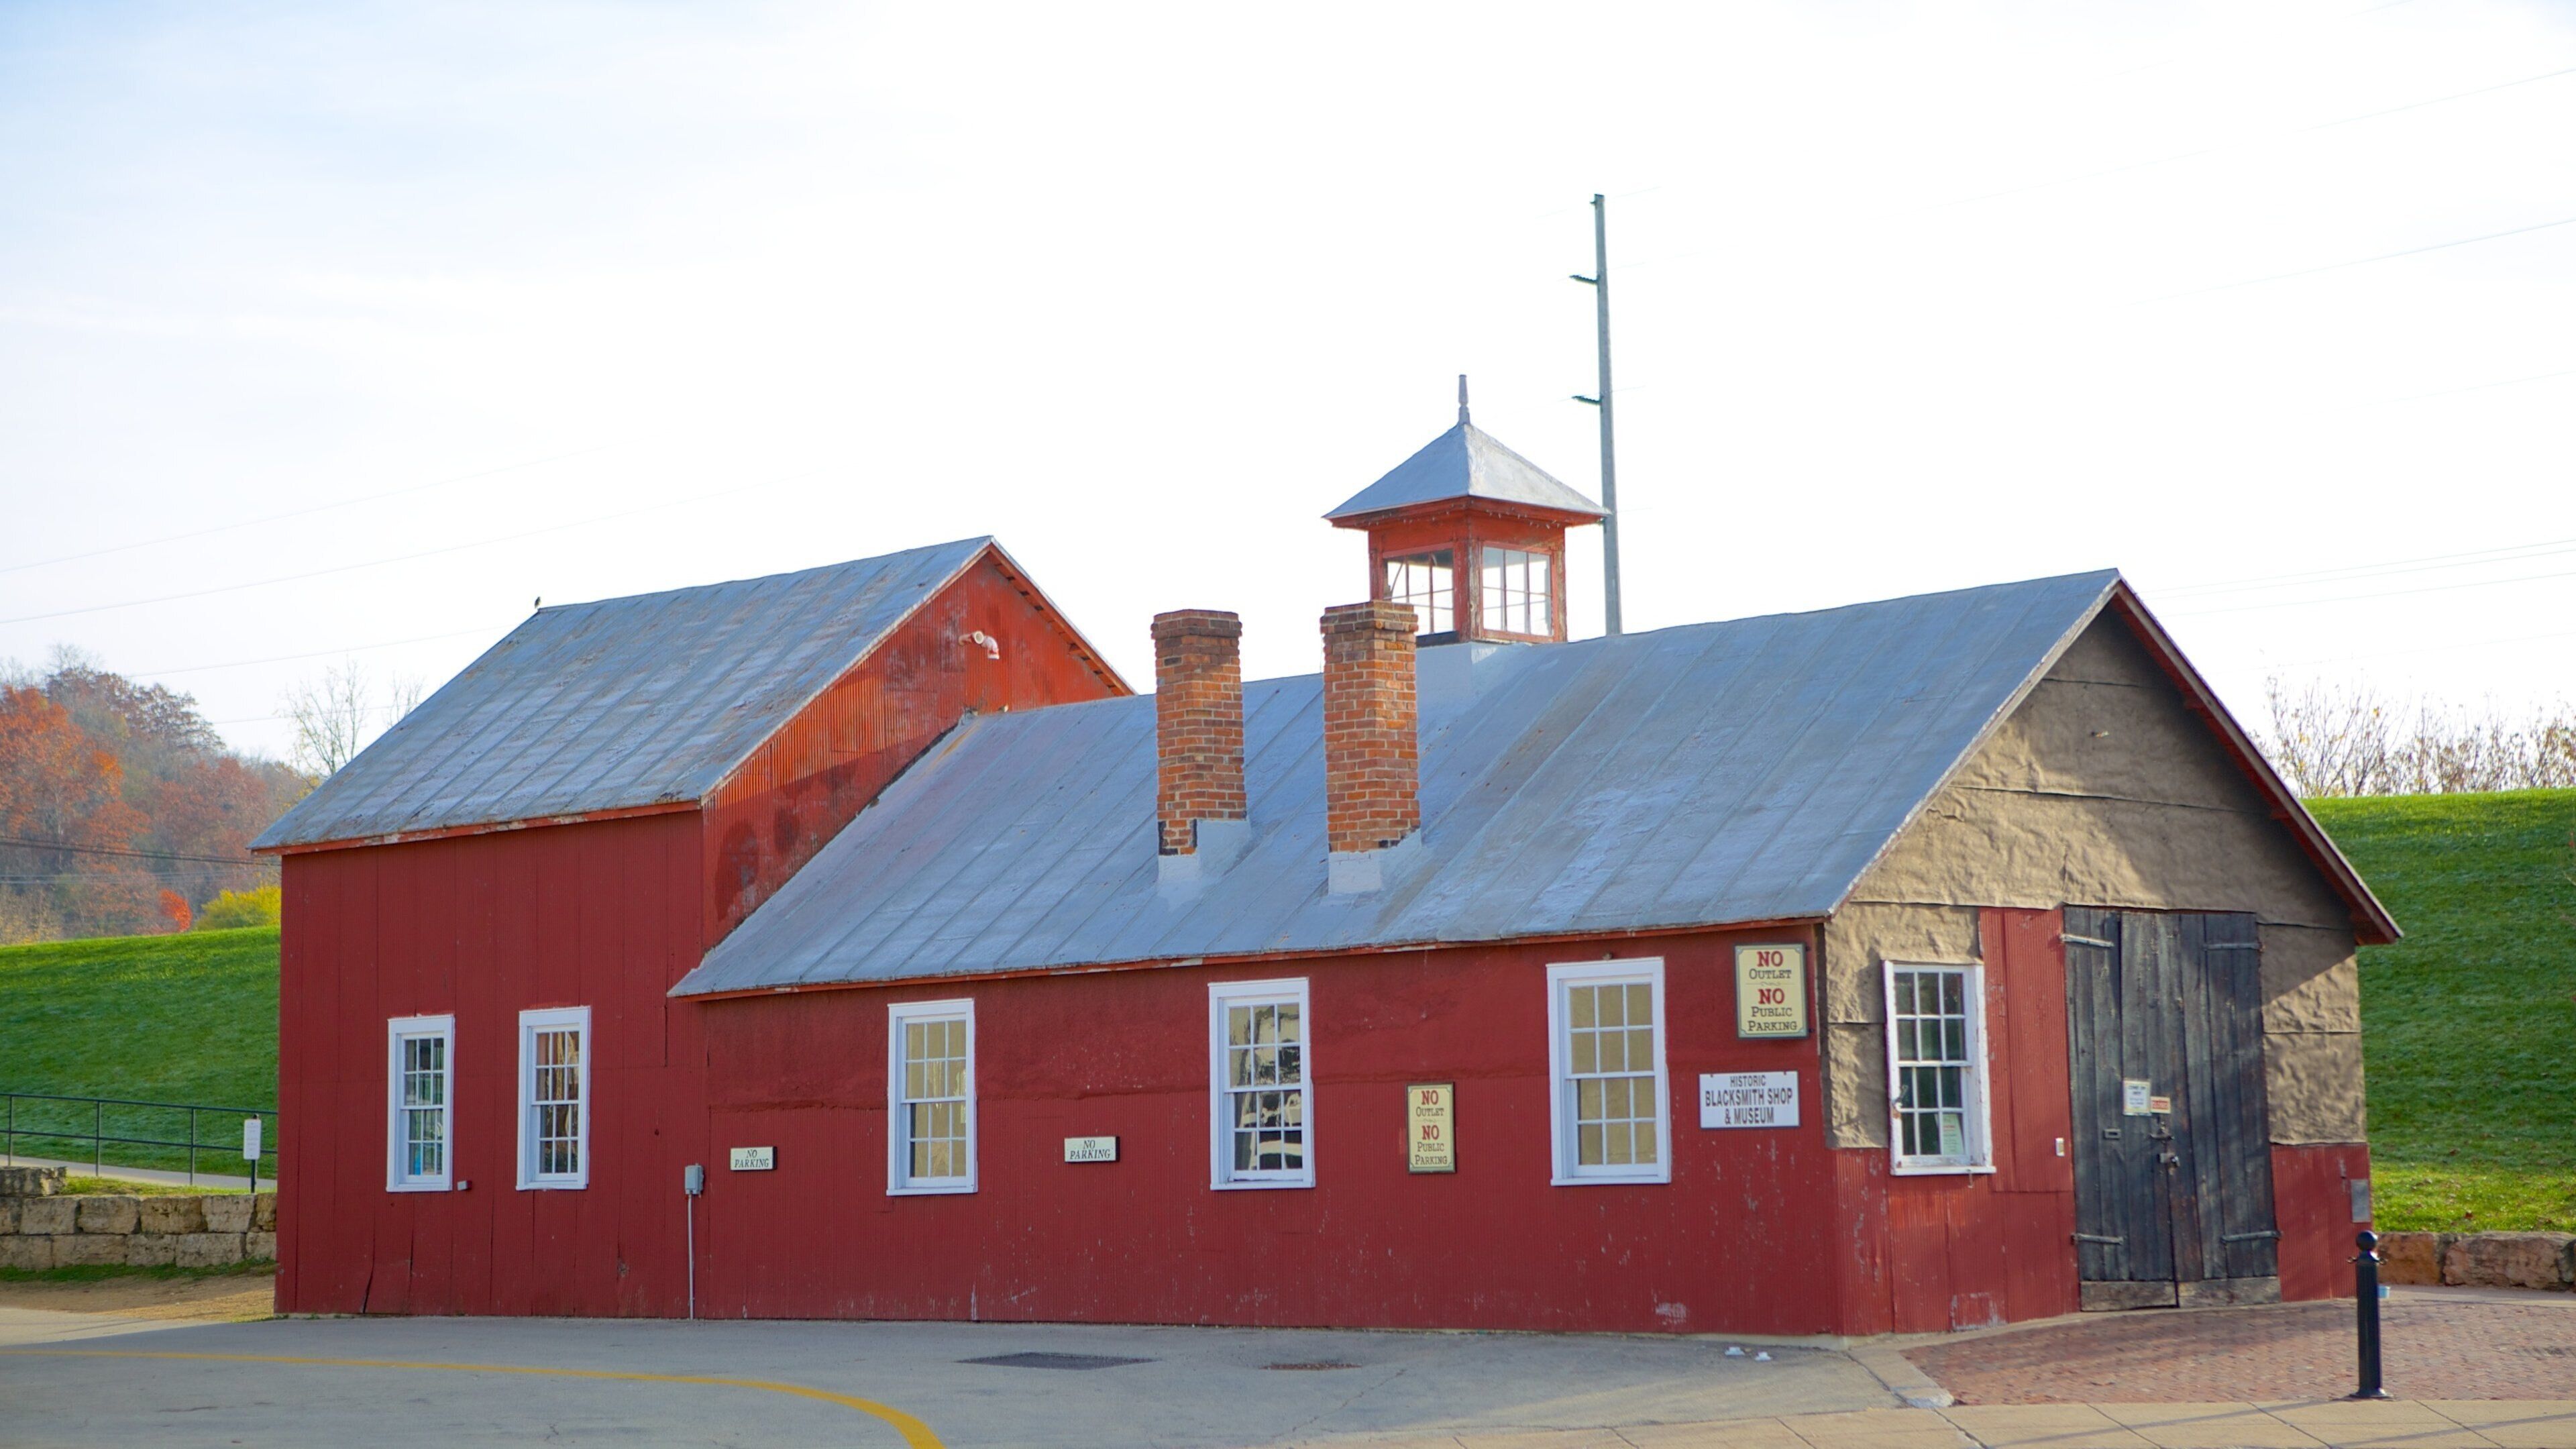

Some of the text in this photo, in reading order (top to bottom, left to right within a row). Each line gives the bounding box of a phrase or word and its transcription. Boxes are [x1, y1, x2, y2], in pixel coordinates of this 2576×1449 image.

[1757, 951, 1783, 967] NO
[1758, 987, 1784, 1004] NO
[1730, 1075, 1766, 1087] HISTORIC
[1421, 1089, 1439, 1106] NO
[1705, 1087, 1792, 1106] BLACKSMITH SHOP
[1725, 1108, 1774, 1124] & MUSEUM
[1421, 1125, 1440, 1140] NO
[1083, 1140, 1095, 1149] NO
[746, 1149, 757, 1159] NO
[1069, 1149, 1110, 1160] PARKING
[735, 1159, 769, 1168] PARKING
